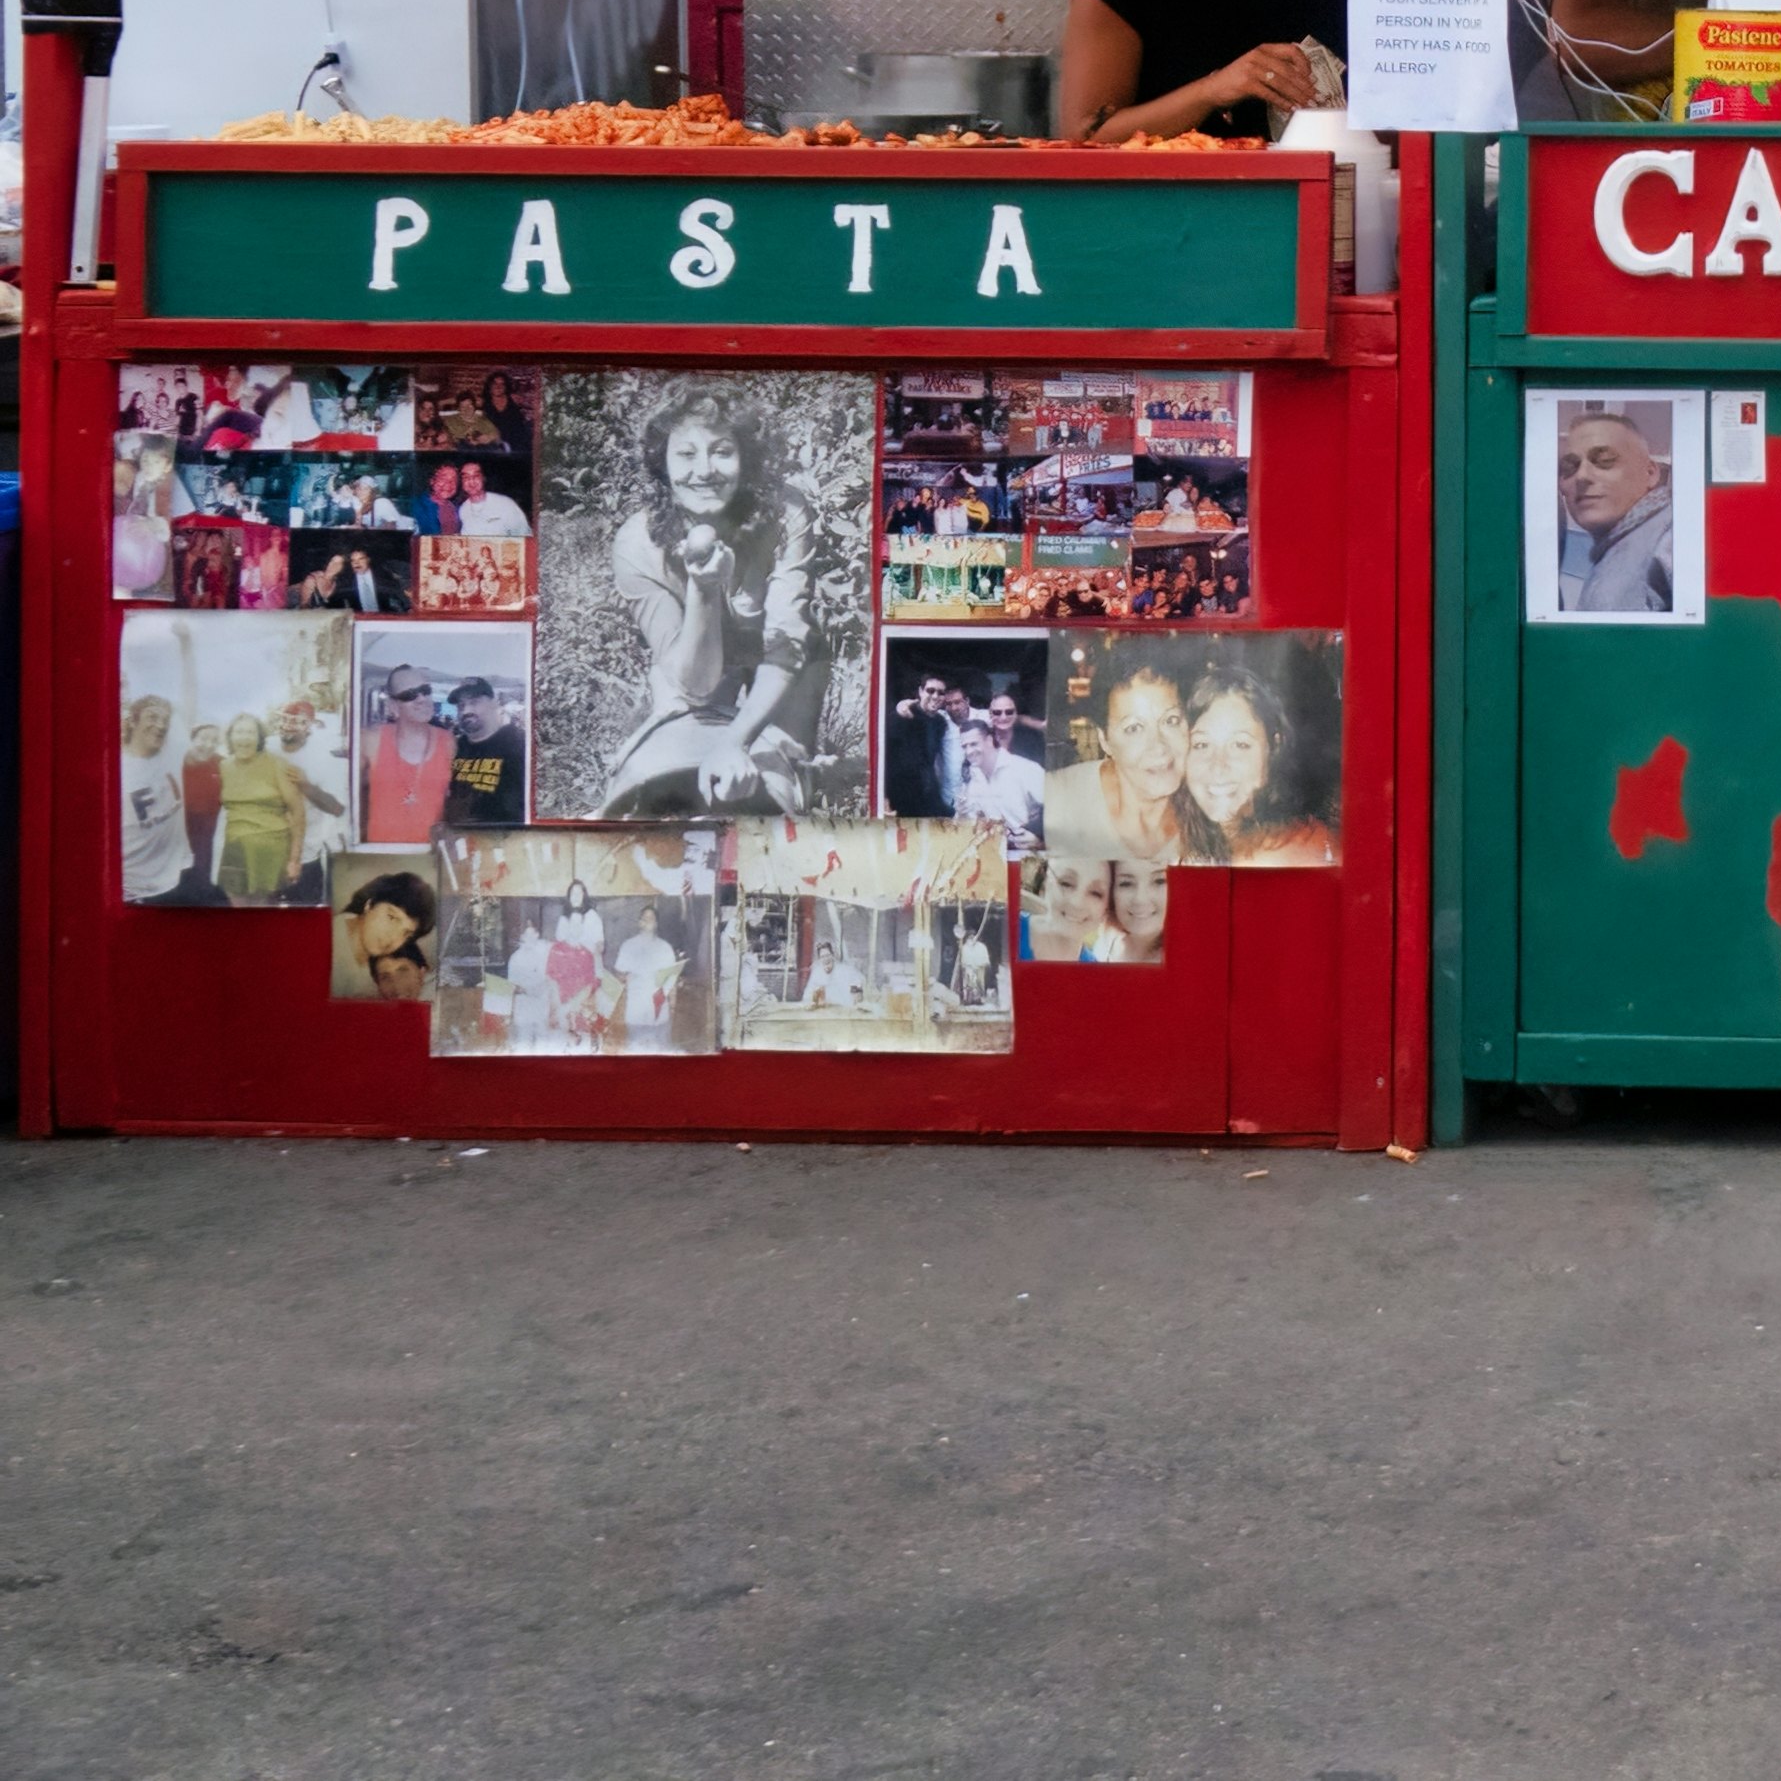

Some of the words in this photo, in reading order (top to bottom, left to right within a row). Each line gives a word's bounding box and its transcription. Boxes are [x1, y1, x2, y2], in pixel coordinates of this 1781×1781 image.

[1376, 15, 1432, 27] PERSON
[1437, 17, 1450, 28] IN
[1454, 18, 1482, 29] YOUR
[1707, 25, 1781, 46] Pastene
[1375, 38, 1419, 50] PARTY
[1423, 39, 1451, 51] HAS
[1455, 41, 1462, 51] A
[1465, 41, 1491, 54] FOOD
[1374, 62, 1437, 74] ALLERGY
[1706, 59, 1781, 72] TOMATOES
